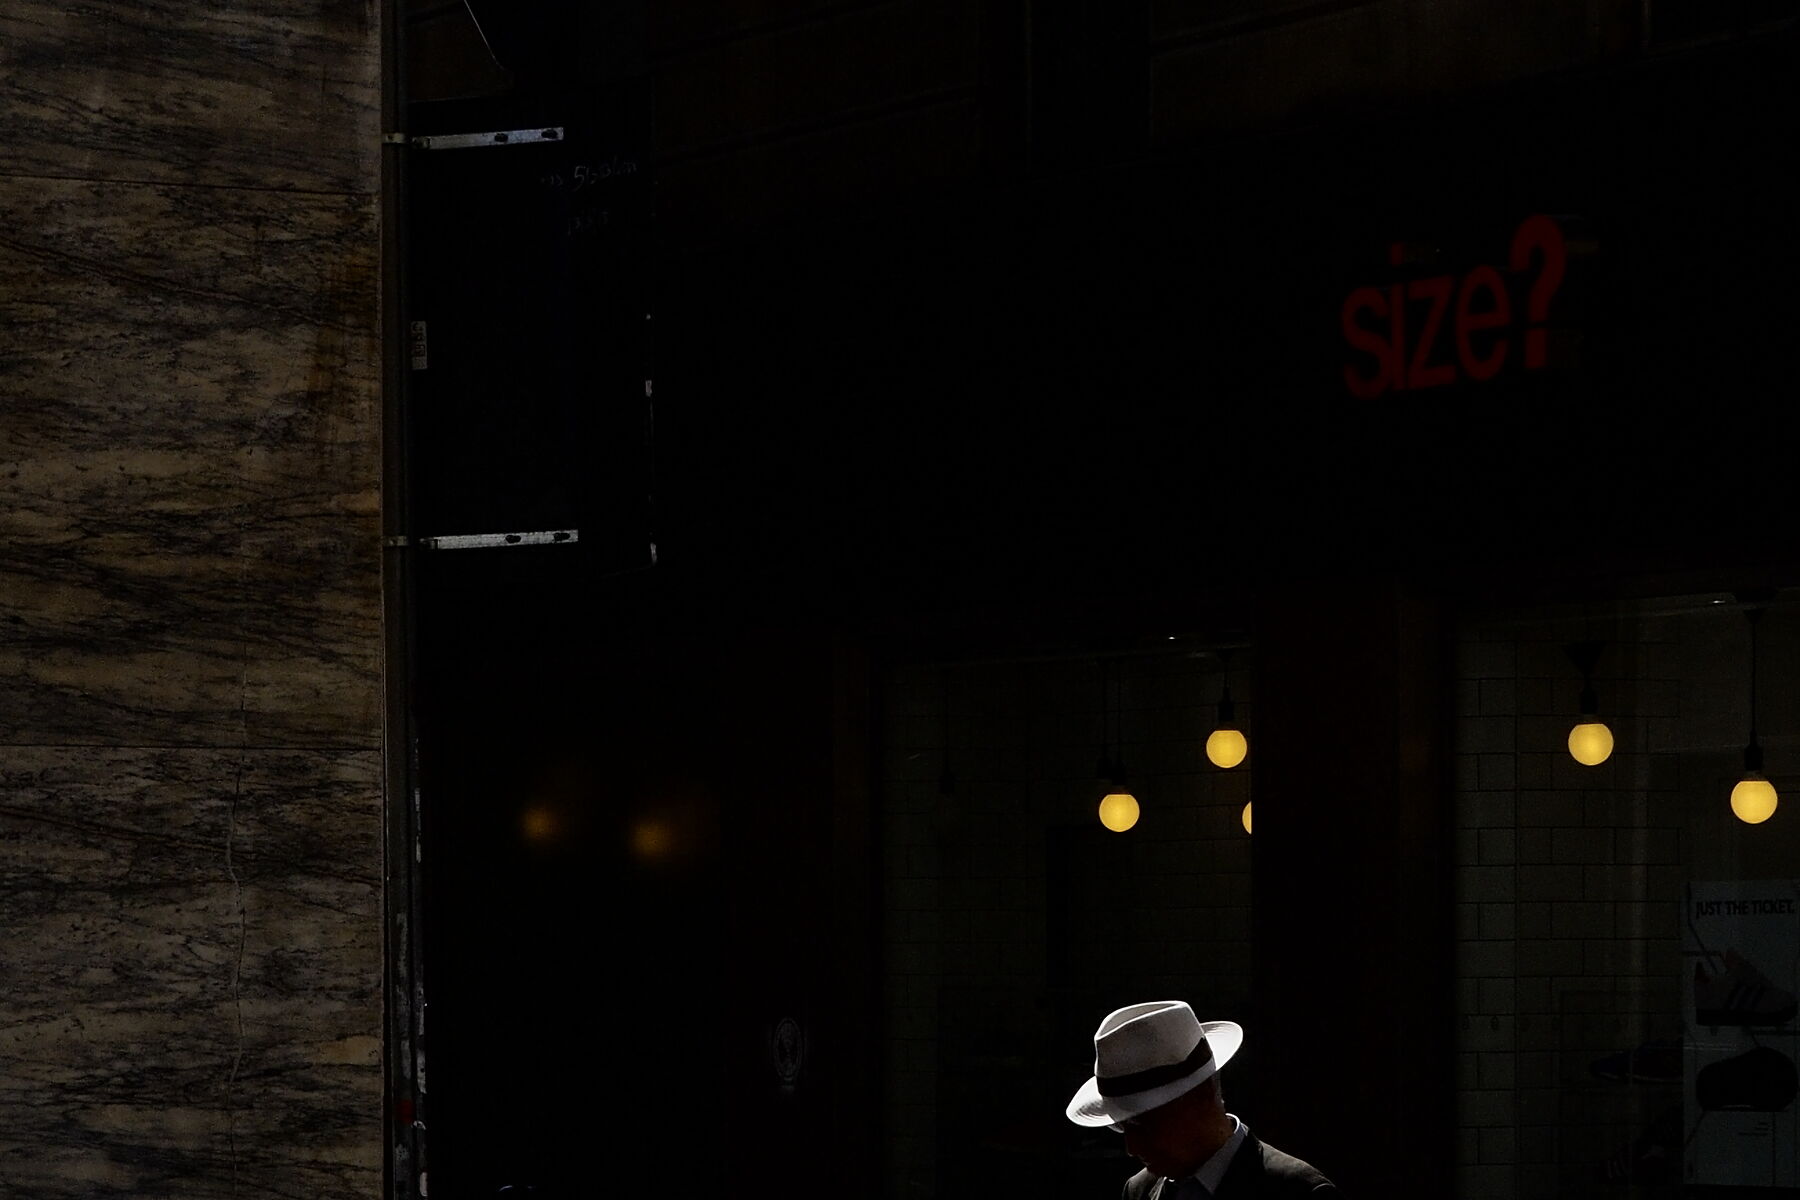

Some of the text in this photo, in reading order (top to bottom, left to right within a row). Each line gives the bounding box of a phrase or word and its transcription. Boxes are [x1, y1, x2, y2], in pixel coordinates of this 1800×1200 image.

[1342, 212, 1568, 400] size?
[1696, 900, 1723, 919] JUST
[1724, 900, 1749, 914] THE
